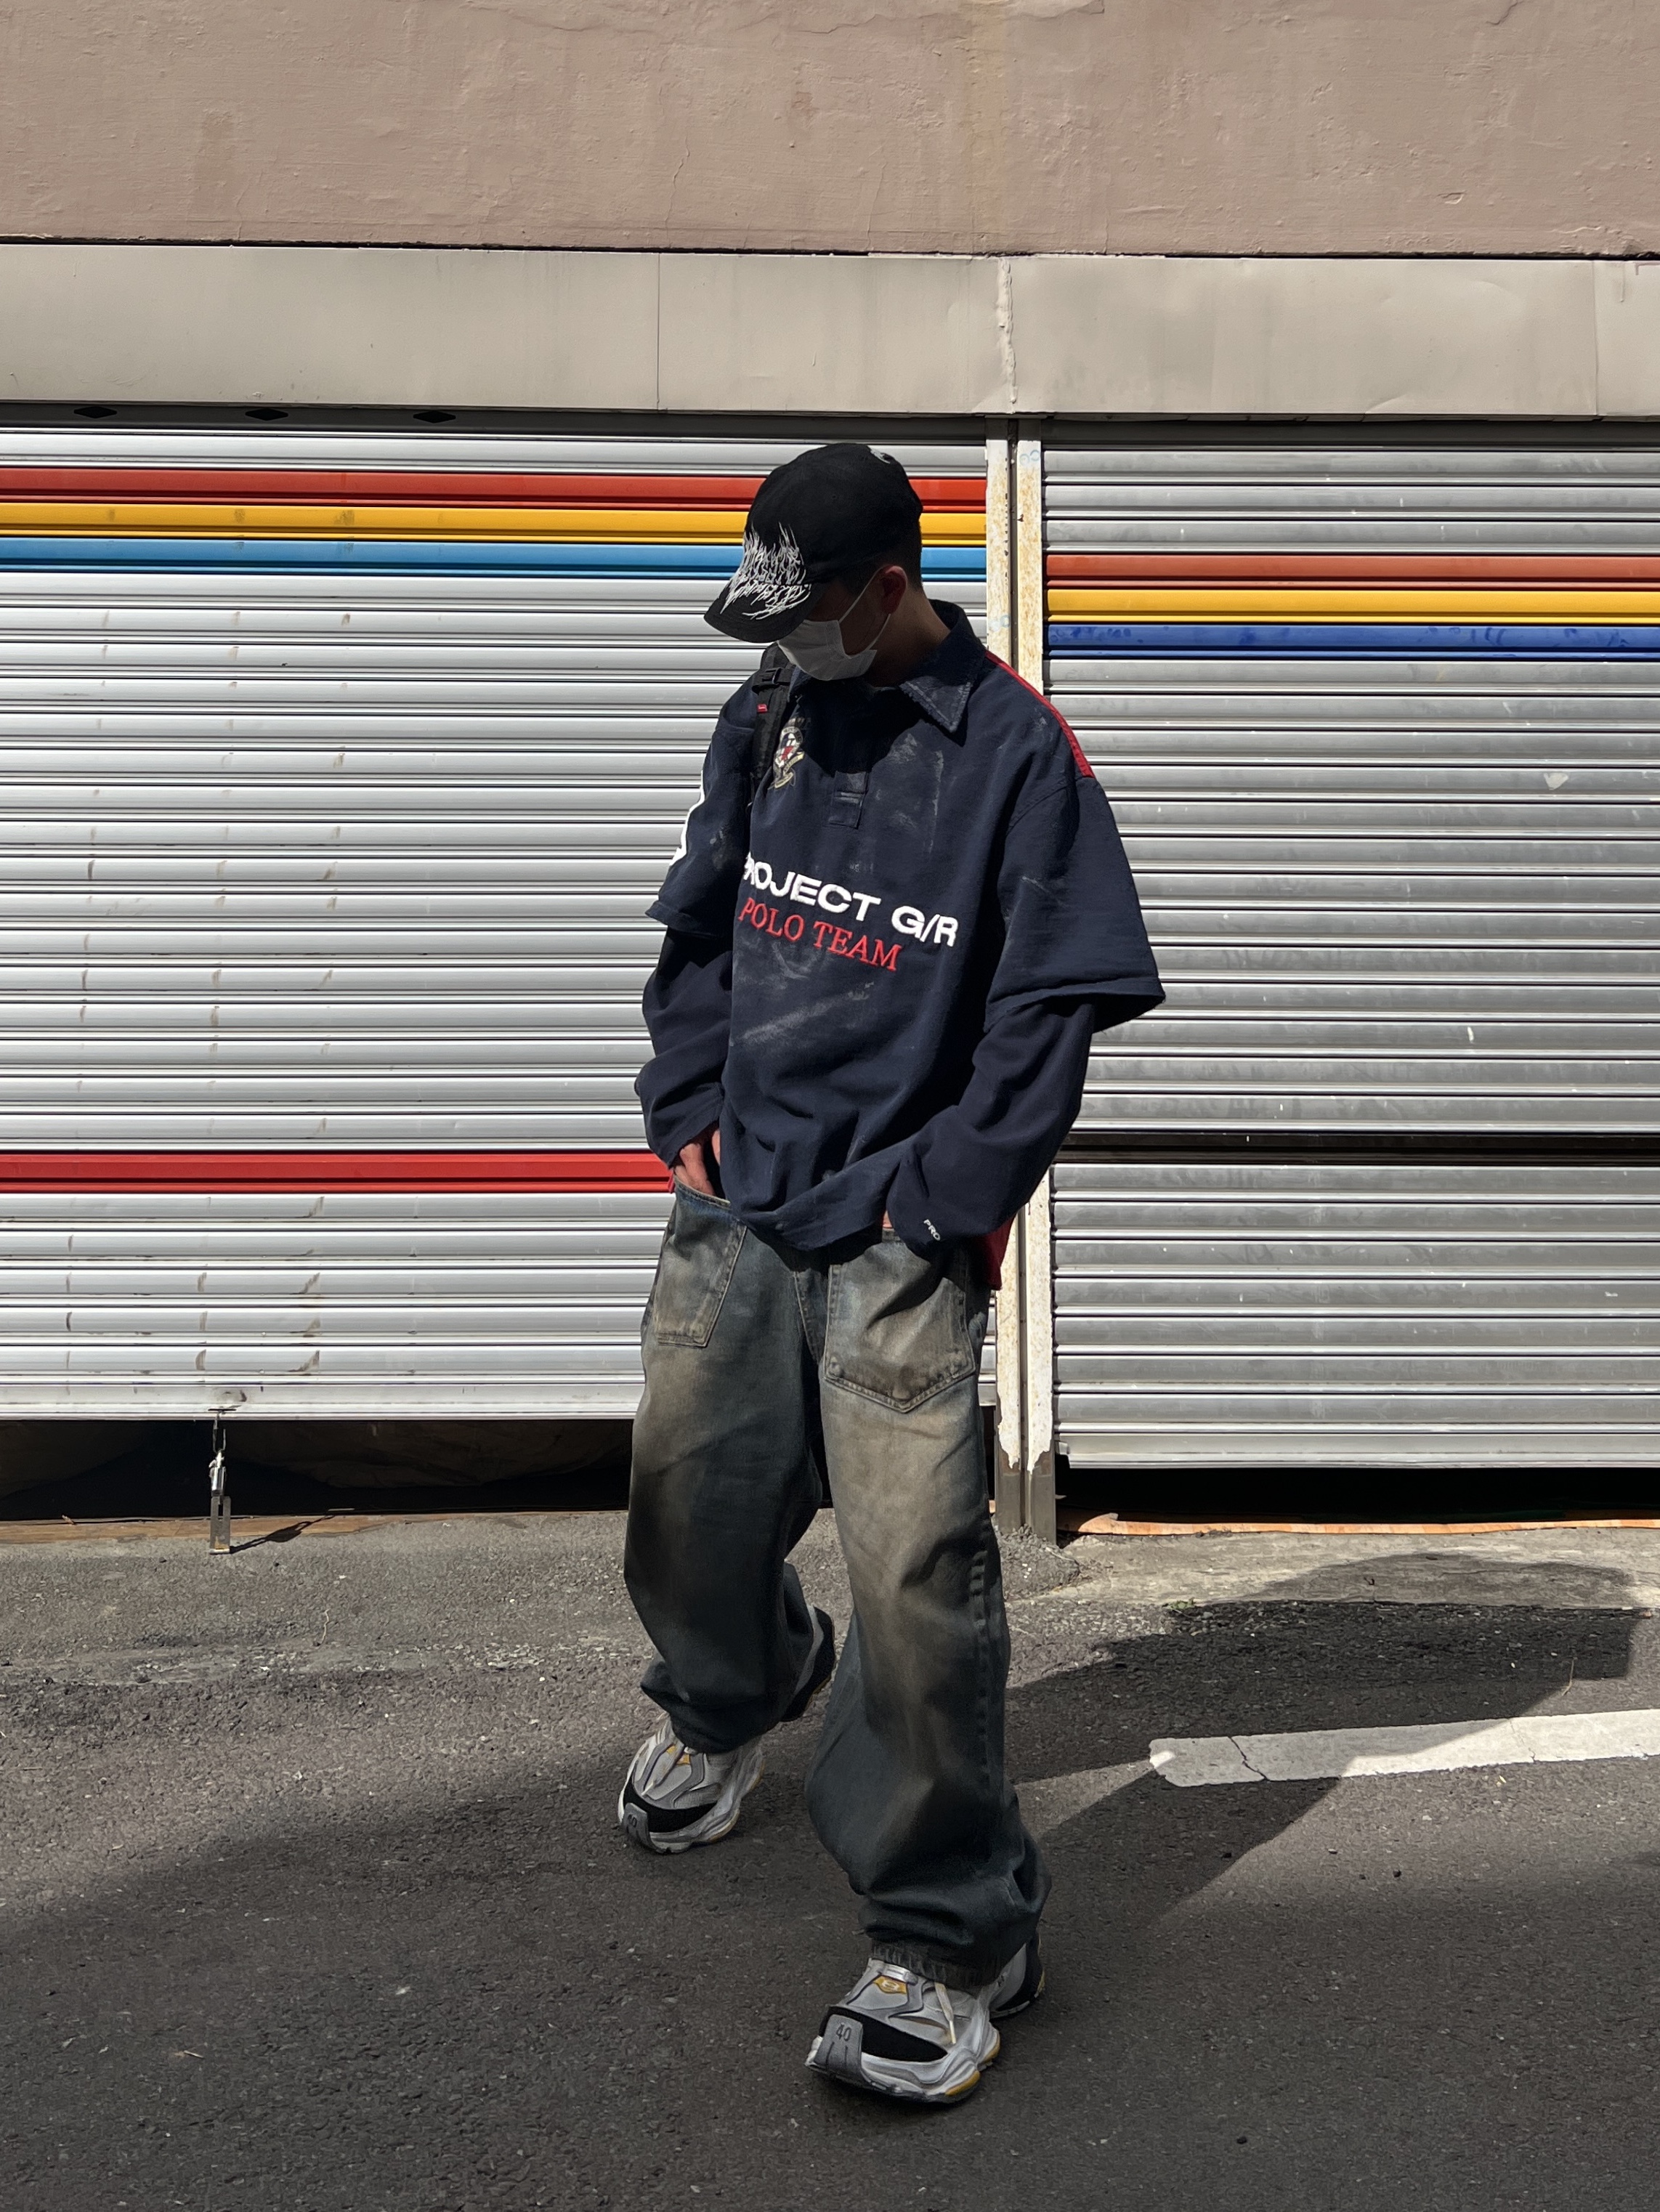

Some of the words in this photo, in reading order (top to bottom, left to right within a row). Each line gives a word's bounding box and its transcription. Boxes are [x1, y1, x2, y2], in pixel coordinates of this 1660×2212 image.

[742, 851, 881, 922] ROJECT
[891, 905, 959, 947] G/R
[738, 897, 805, 942] POLO
[813, 920, 902, 972] TEAM
[923, 1219, 941, 1241] PRO
[836, 2024, 851, 2041] 40
